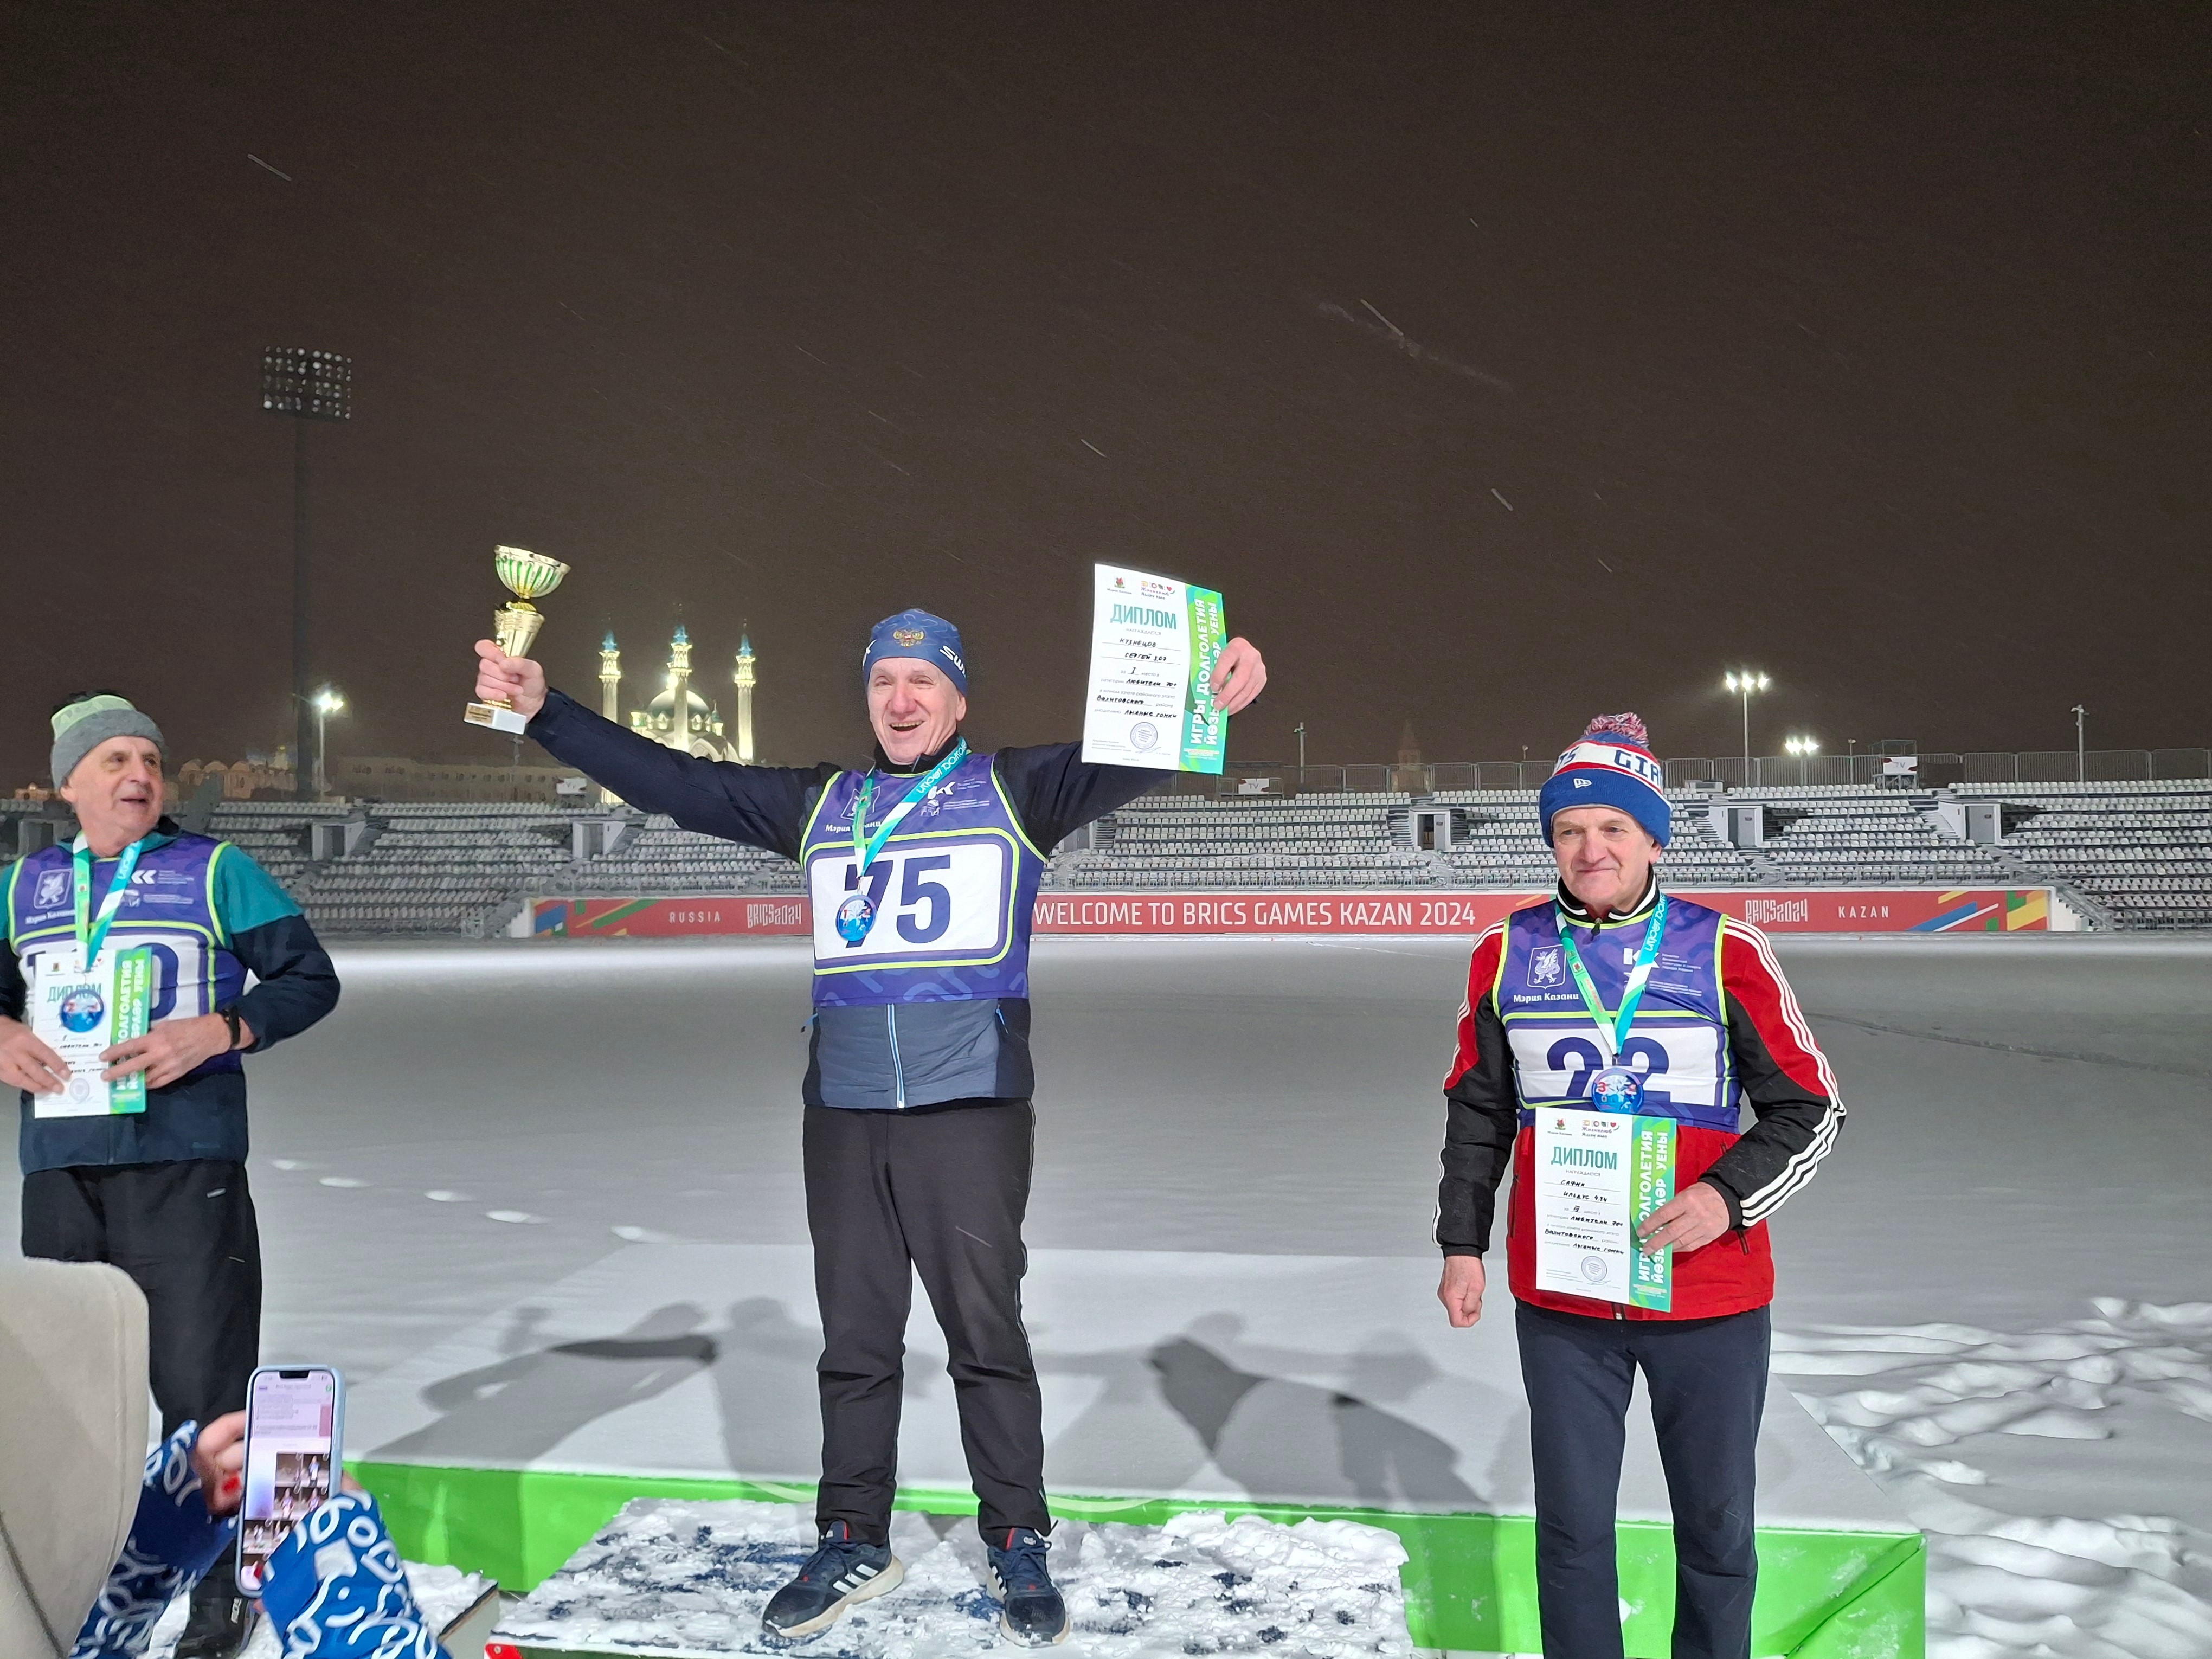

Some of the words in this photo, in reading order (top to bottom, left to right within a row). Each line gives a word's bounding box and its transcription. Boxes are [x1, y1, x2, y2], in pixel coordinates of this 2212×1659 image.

[1110, 603, 1176, 629] ДИПЛОМ
[1208, 602, 1219, 635] УЕНЫ
[1119, 638, 1156, 648] КУЗНЕЦОВ
[1194, 598, 1211, 696] ДОЛГОЛЕТИЯ
[1190, 699, 1206, 744] ИГРЫ
[1614, 749, 1661, 786] GIA
[825, 824, 851, 833] Мэрия
[844, 854, 951, 948] 75
[1033, 902, 1143, 925] WELCOME
[1148, 902, 1174, 925] TO
[1184, 902, 1246, 925] BRICS
[1255, 902, 1332, 925] GAMES
[1340, 902, 1412, 925] KAZAN
[1420, 902, 1476, 925] 2024
[1838, 906, 1889, 918] KAZAN
[669, 911, 721, 923] RUSSIA
[118, 960, 132, 1044] ОЛГОЛЕТИЯ
[1513, 994, 1542, 1004] Мэрия
[1544, 993, 1579, 1001] Казани
[1547, 1037, 1671, 1102] 22
[1551, 1146, 1617, 1170] ДИПЛОМ
[1656, 1131, 1668, 1171] УЕНЫ
[1638, 1130, 1654, 1223] ОЛГОЛЕТИЯ
[1564, 1191, 1589, 1200] ИЛЬДУС
